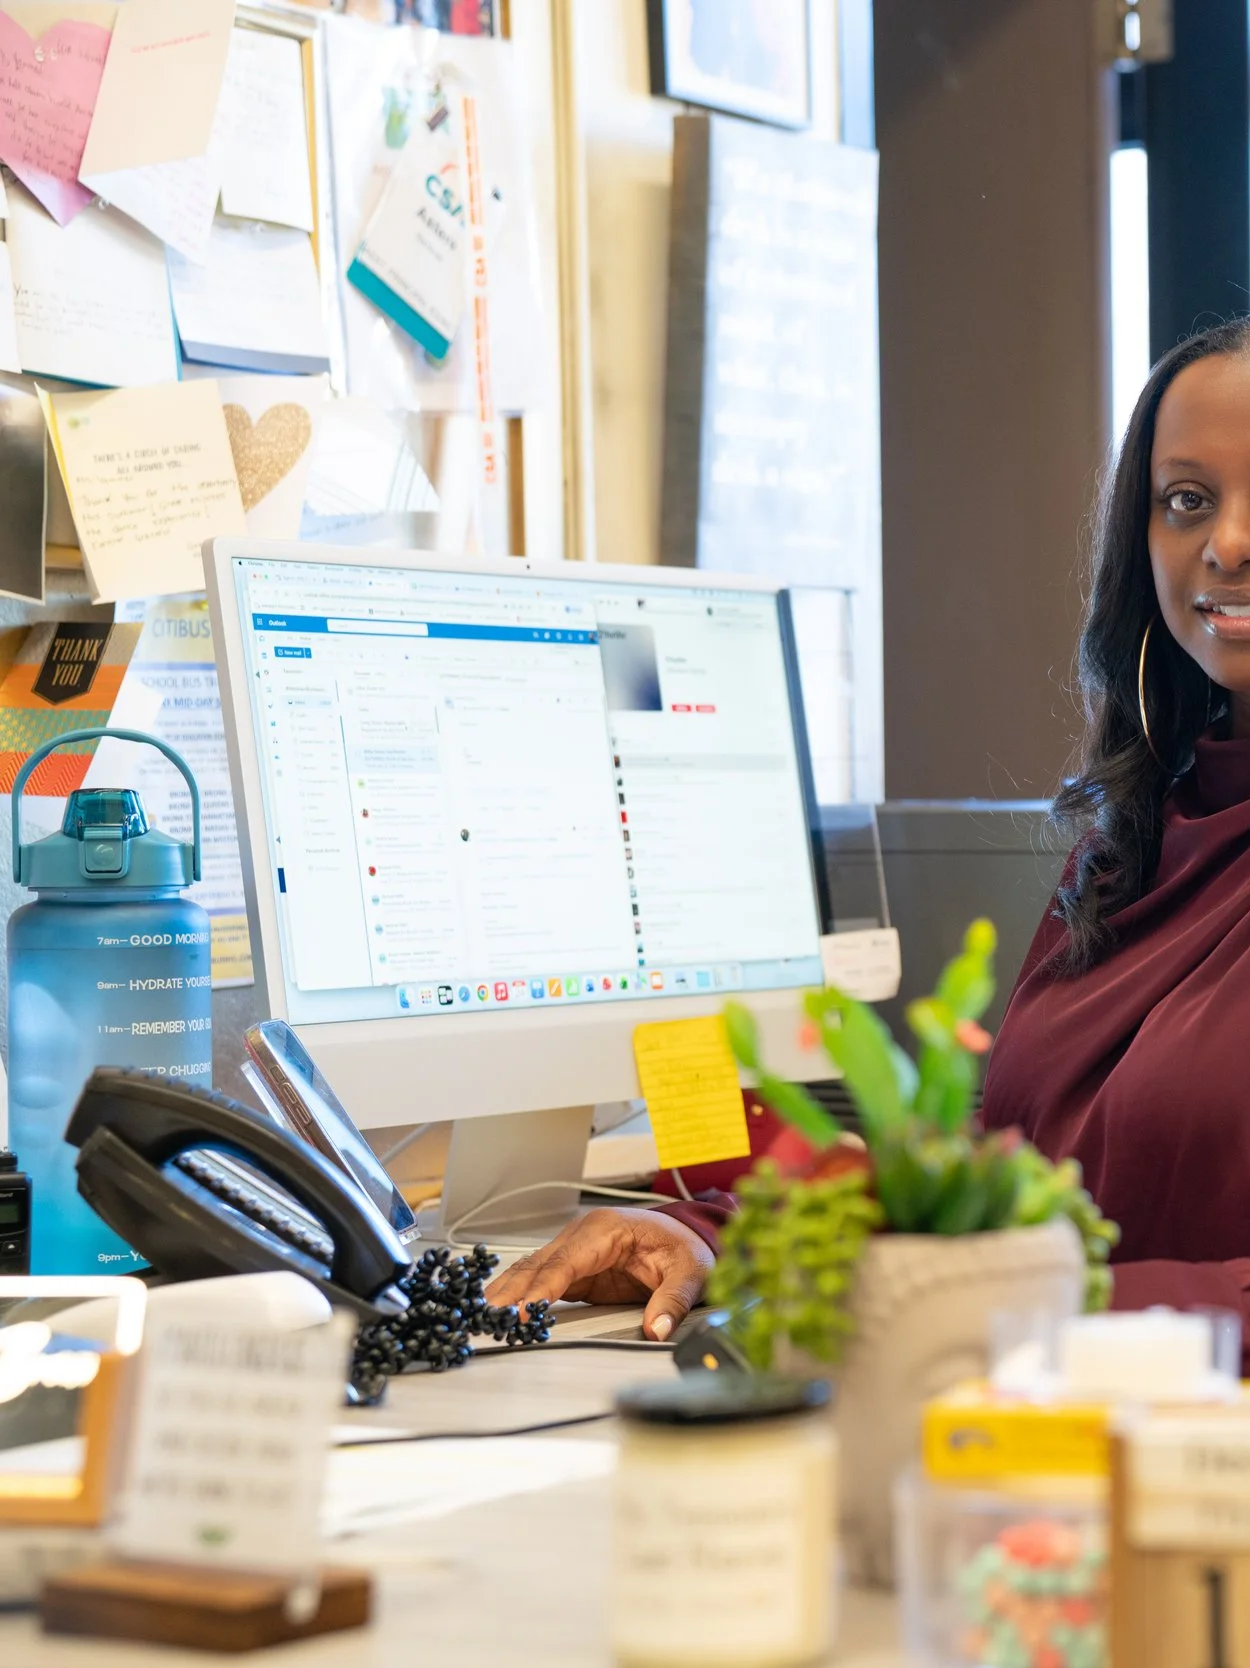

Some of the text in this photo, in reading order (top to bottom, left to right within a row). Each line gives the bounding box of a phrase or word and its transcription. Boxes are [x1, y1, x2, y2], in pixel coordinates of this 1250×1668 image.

[151, 617, 212, 640] CITIBUS
[52, 638, 104, 661] THANK
[129, 933, 173, 946] GOOD
[129, 977, 184, 991] HYDRATE
[131, 1020, 187, 1036] REMEMBER
[188, 1018, 204, 1032] YOUR
